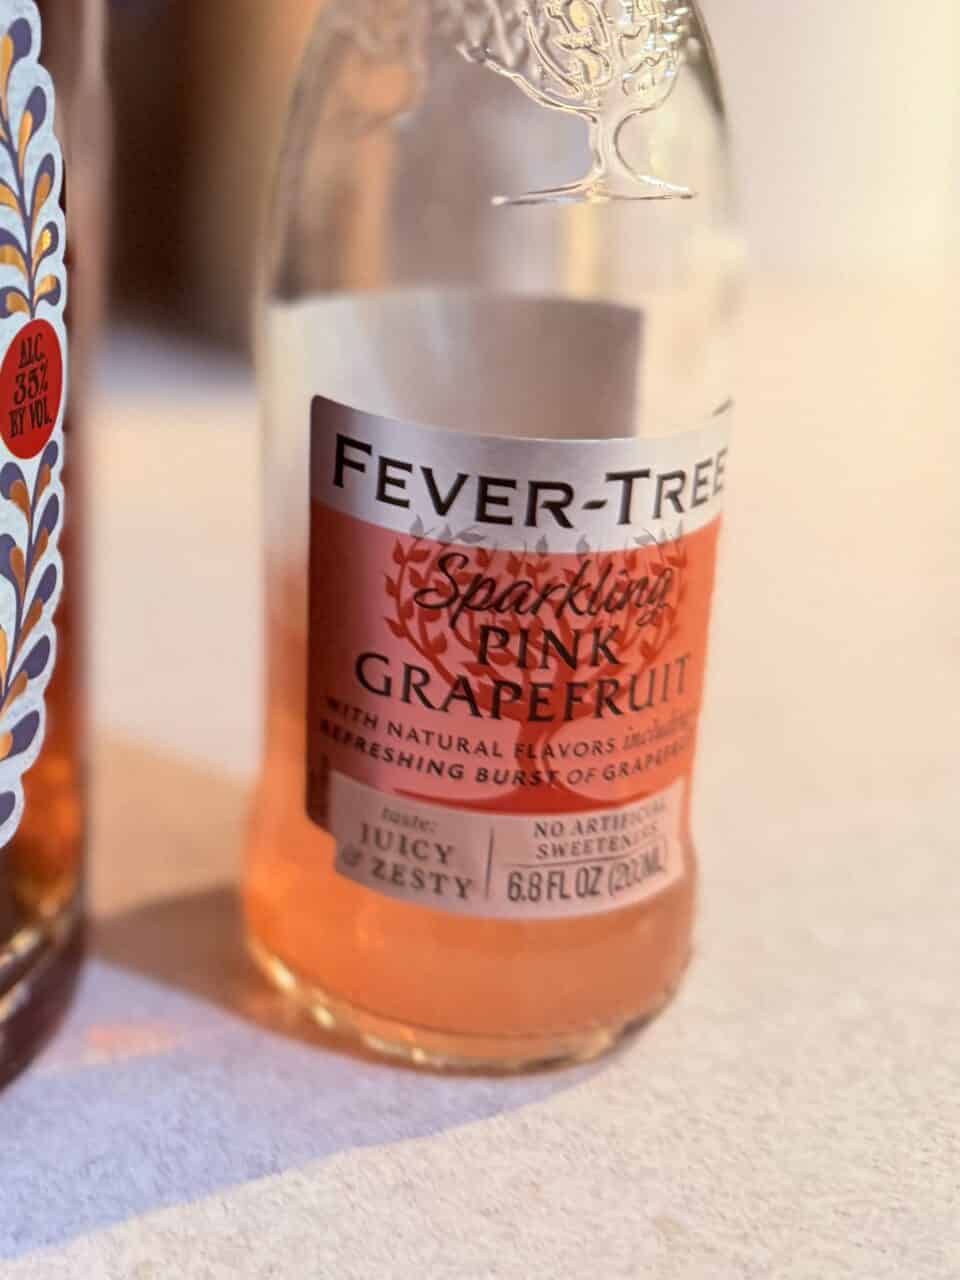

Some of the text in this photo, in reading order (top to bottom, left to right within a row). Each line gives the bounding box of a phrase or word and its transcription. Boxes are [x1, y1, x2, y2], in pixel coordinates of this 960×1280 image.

[8, 405, 27, 438] BY
[332, 433, 728, 528] FEVER-TREE
[413, 551, 674, 629] Sparkling
[477, 624, 621, 671] PINK
[354, 652, 689, 723] GRAPEFRUIT
[386, 720, 503, 759] NATURAL
[513, 735, 618, 761] FLAVORS
[474, 767, 558, 788] BURST
[567, 767, 597, 785] OF
[533, 799, 665, 838] NO ARTIF
[360, 821, 455, 865] JUICY
[535, 823, 658, 860] SWEETENS
[369, 857, 474, 900] ZESTY
[506, 870, 543, 904] 6.8
[546, 869, 571, 901] FL
[575, 865, 604, 898] OZ
